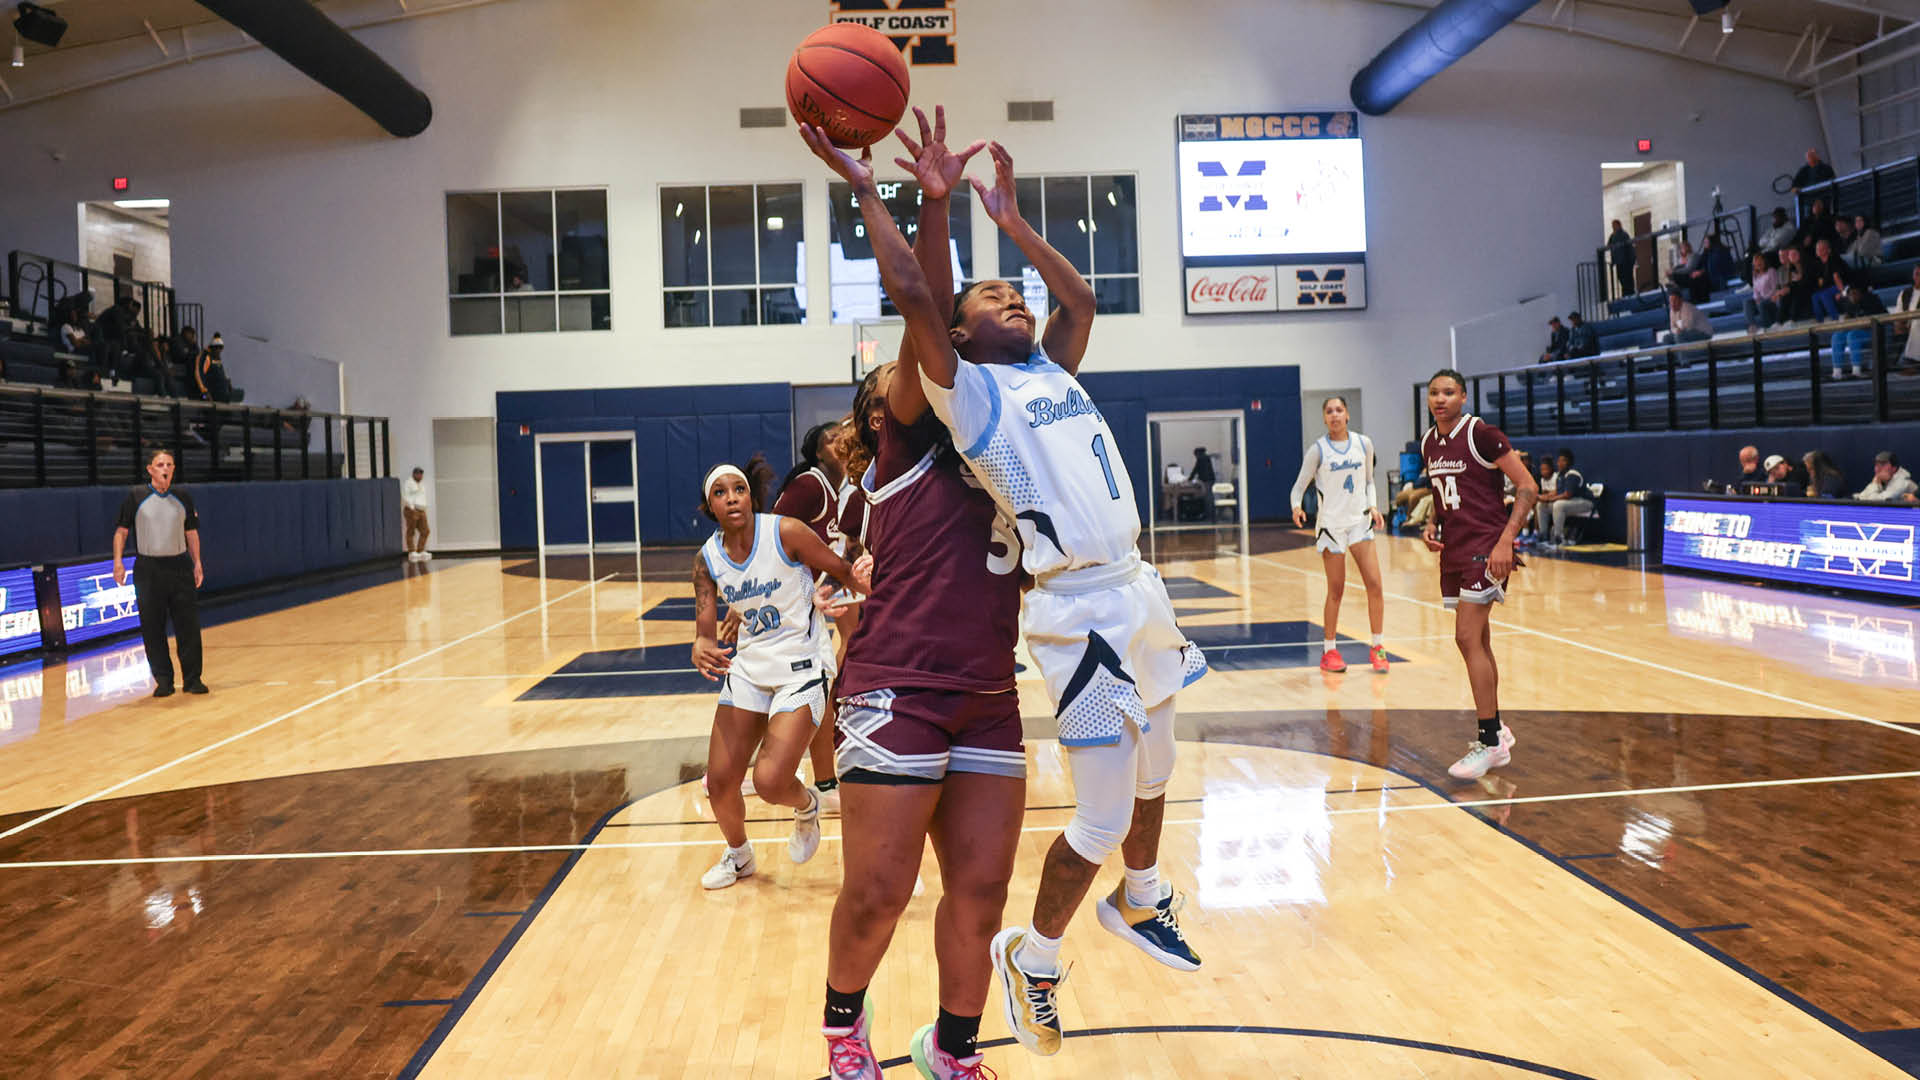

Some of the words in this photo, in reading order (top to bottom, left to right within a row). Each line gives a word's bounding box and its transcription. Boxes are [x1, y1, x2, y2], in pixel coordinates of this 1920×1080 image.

[888, 15, 949, 30] COAST
[1320, 283, 1345, 291] COAST
[1091, 433, 1121, 500] 1
[1343, 474, 1354, 494] 4
[1673, 510, 1721, 536] COME
[1725, 513, 1752, 538] TO
[1700, 535, 1735, 560] THE
[1738, 539, 1806, 568] COAST
[723, 577, 782, 603] Bulldogs
[743, 604, 781, 636] 20
